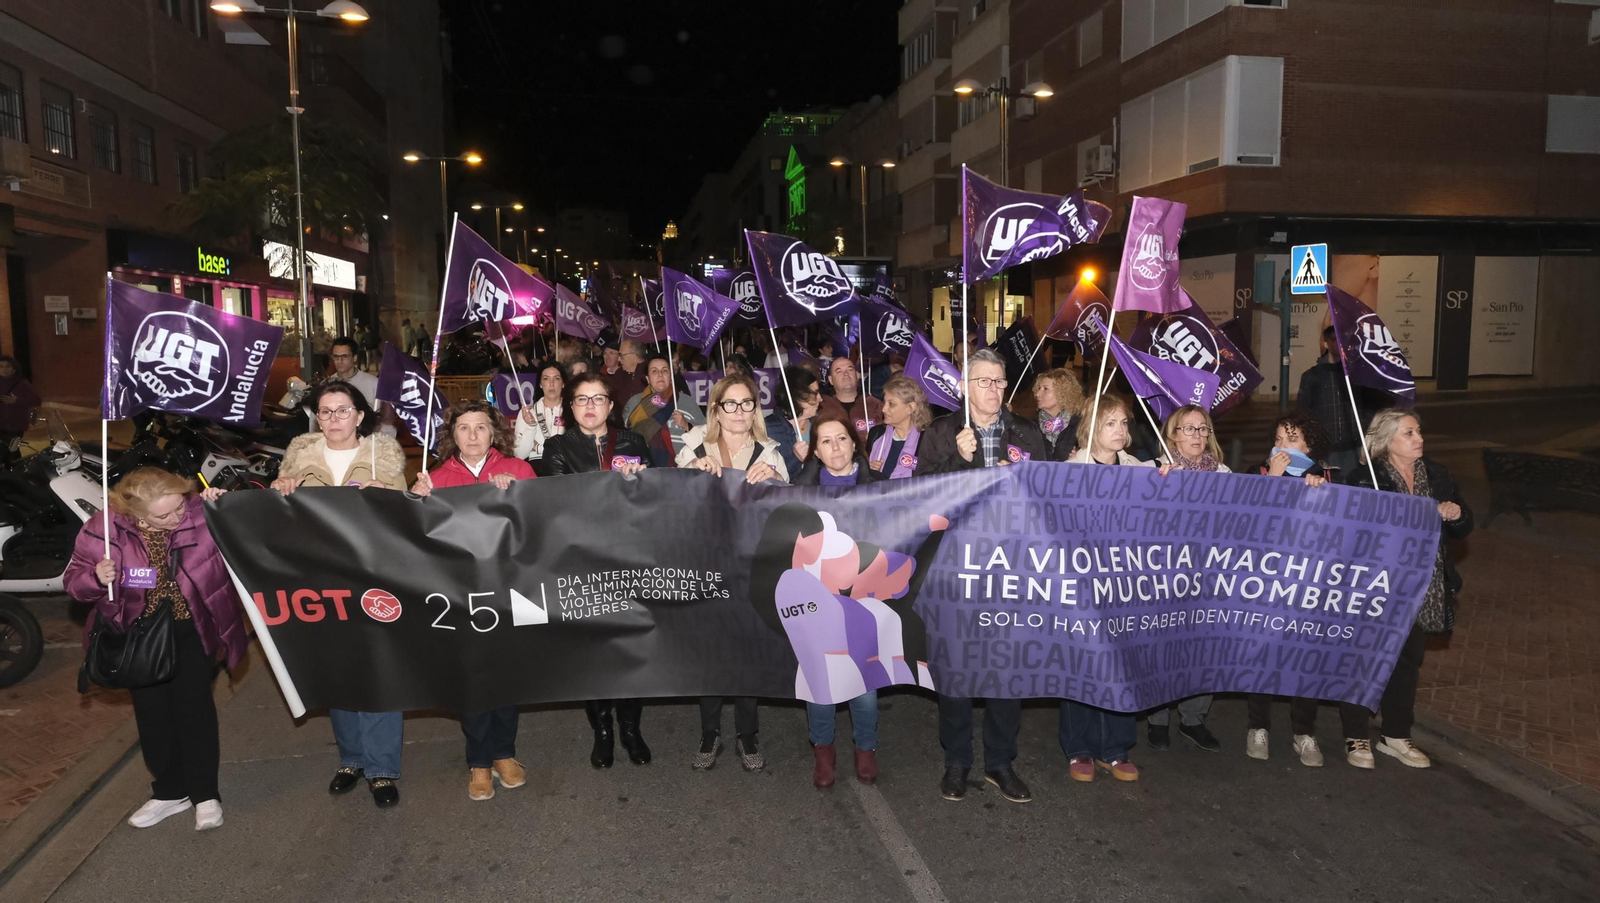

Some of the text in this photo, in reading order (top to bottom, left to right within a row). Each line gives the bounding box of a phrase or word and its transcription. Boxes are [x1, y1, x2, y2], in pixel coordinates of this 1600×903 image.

[472, 266, 509, 322] UGT
[677, 288, 703, 318] UGT
[1235, 288, 1253, 309] SP
[1445, 290, 1469, 309] SP
[558, 299, 588, 323] UGT
[1489, 301, 1507, 313] San
[134, 324, 220, 381] UGT
[1163, 320, 1215, 370] UGT
[223, 339, 270, 422] Andalucía
[130, 569, 152, 577] UGT
[557, 567, 723, 590] DÍA INTERNACIONAL DE
[963, 543, 1011, 571] LA
[1028, 544, 1193, 575] VIOLENCIA
[1205, 546, 1391, 594] MACHISTA
[558, 576, 718, 599] LA ELIMINACIÓN DE LA
[559, 588, 730, 610] VIOLENCIA CONTRA LAS
[957, 572, 1388, 618] TIENE MUCHOS NOMBRES
[253, 588, 352, 626] UGT
[561, 600, 634, 622] MUJERES.
[781, 604, 806, 619] UGT
[978, 608, 1355, 639] SOLO HAY QUE SABER IDENTIFICARLOS
